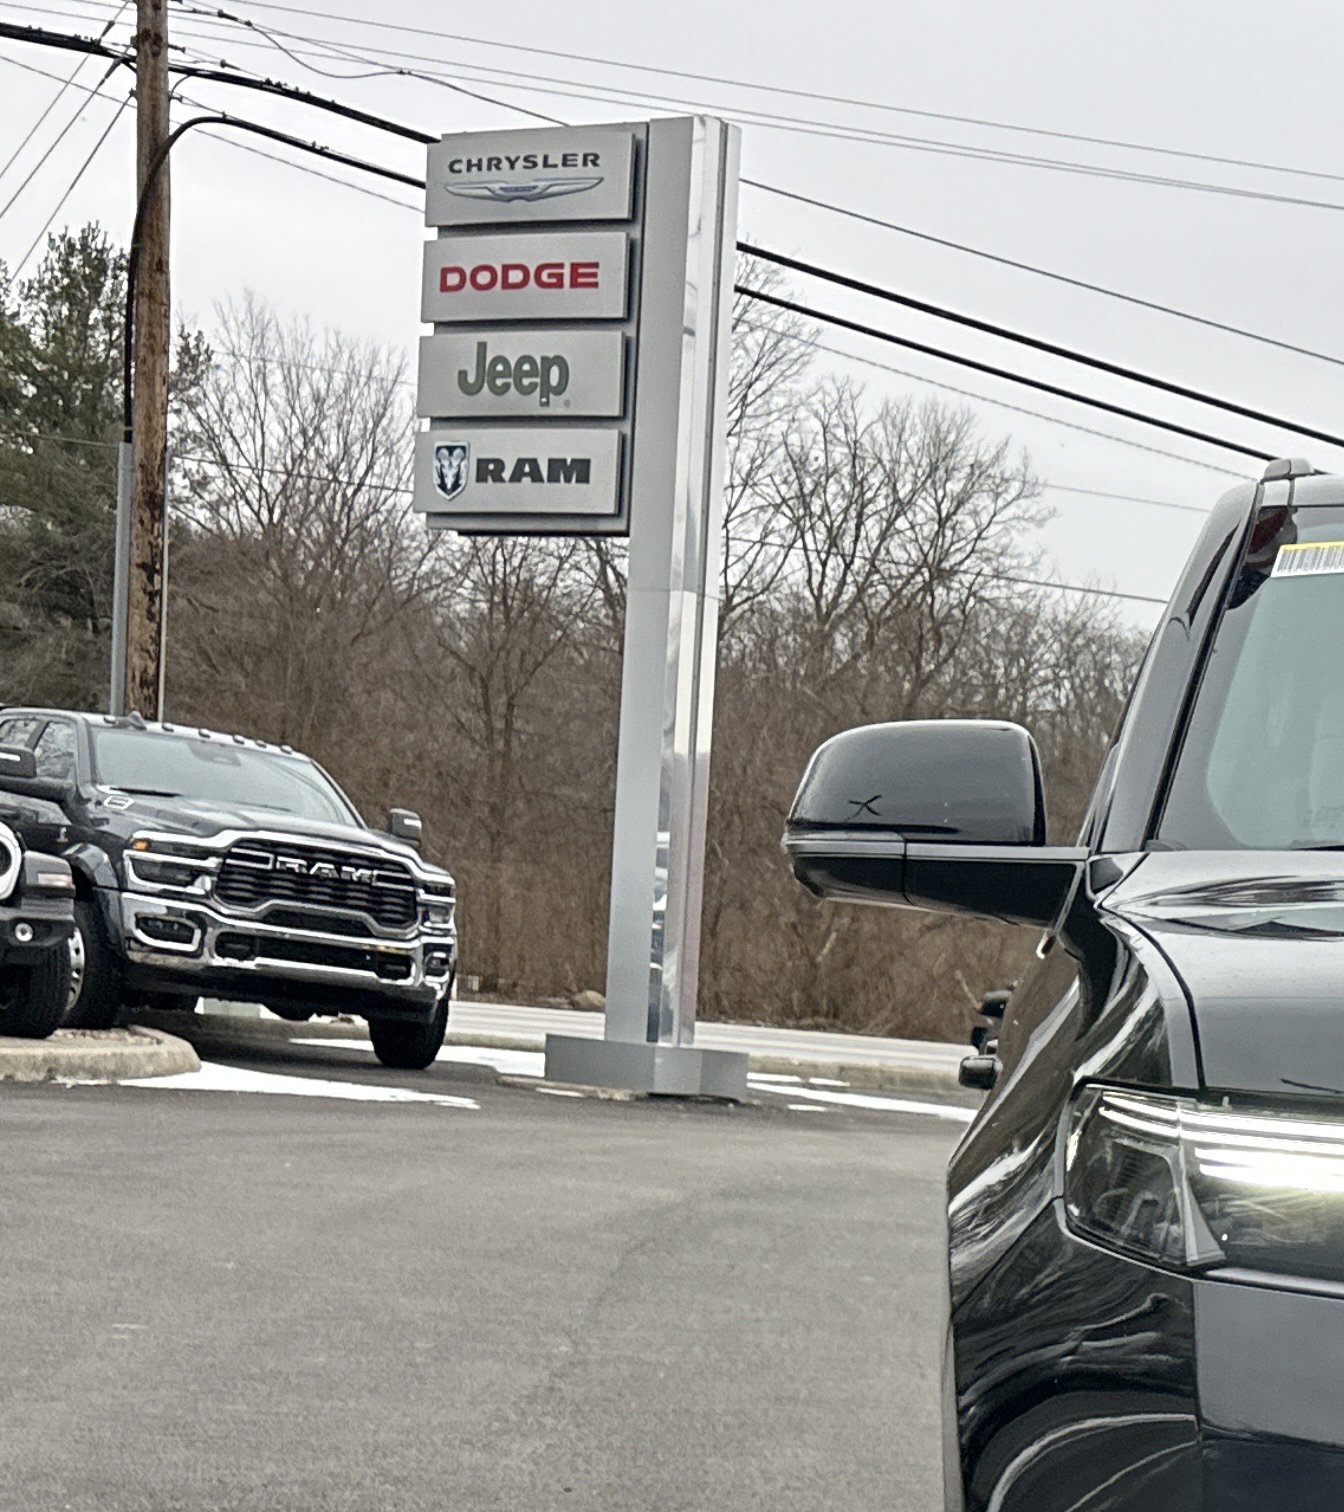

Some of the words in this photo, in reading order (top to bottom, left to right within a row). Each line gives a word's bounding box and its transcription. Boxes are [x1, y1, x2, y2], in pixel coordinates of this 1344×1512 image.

[448, 152, 600, 174] CHRYSLER
[439, 262, 600, 293] DODGE
[457, 341, 570, 407] Jeep
[475, 457, 591, 485] RAM
[276, 856, 372, 884] RAM
